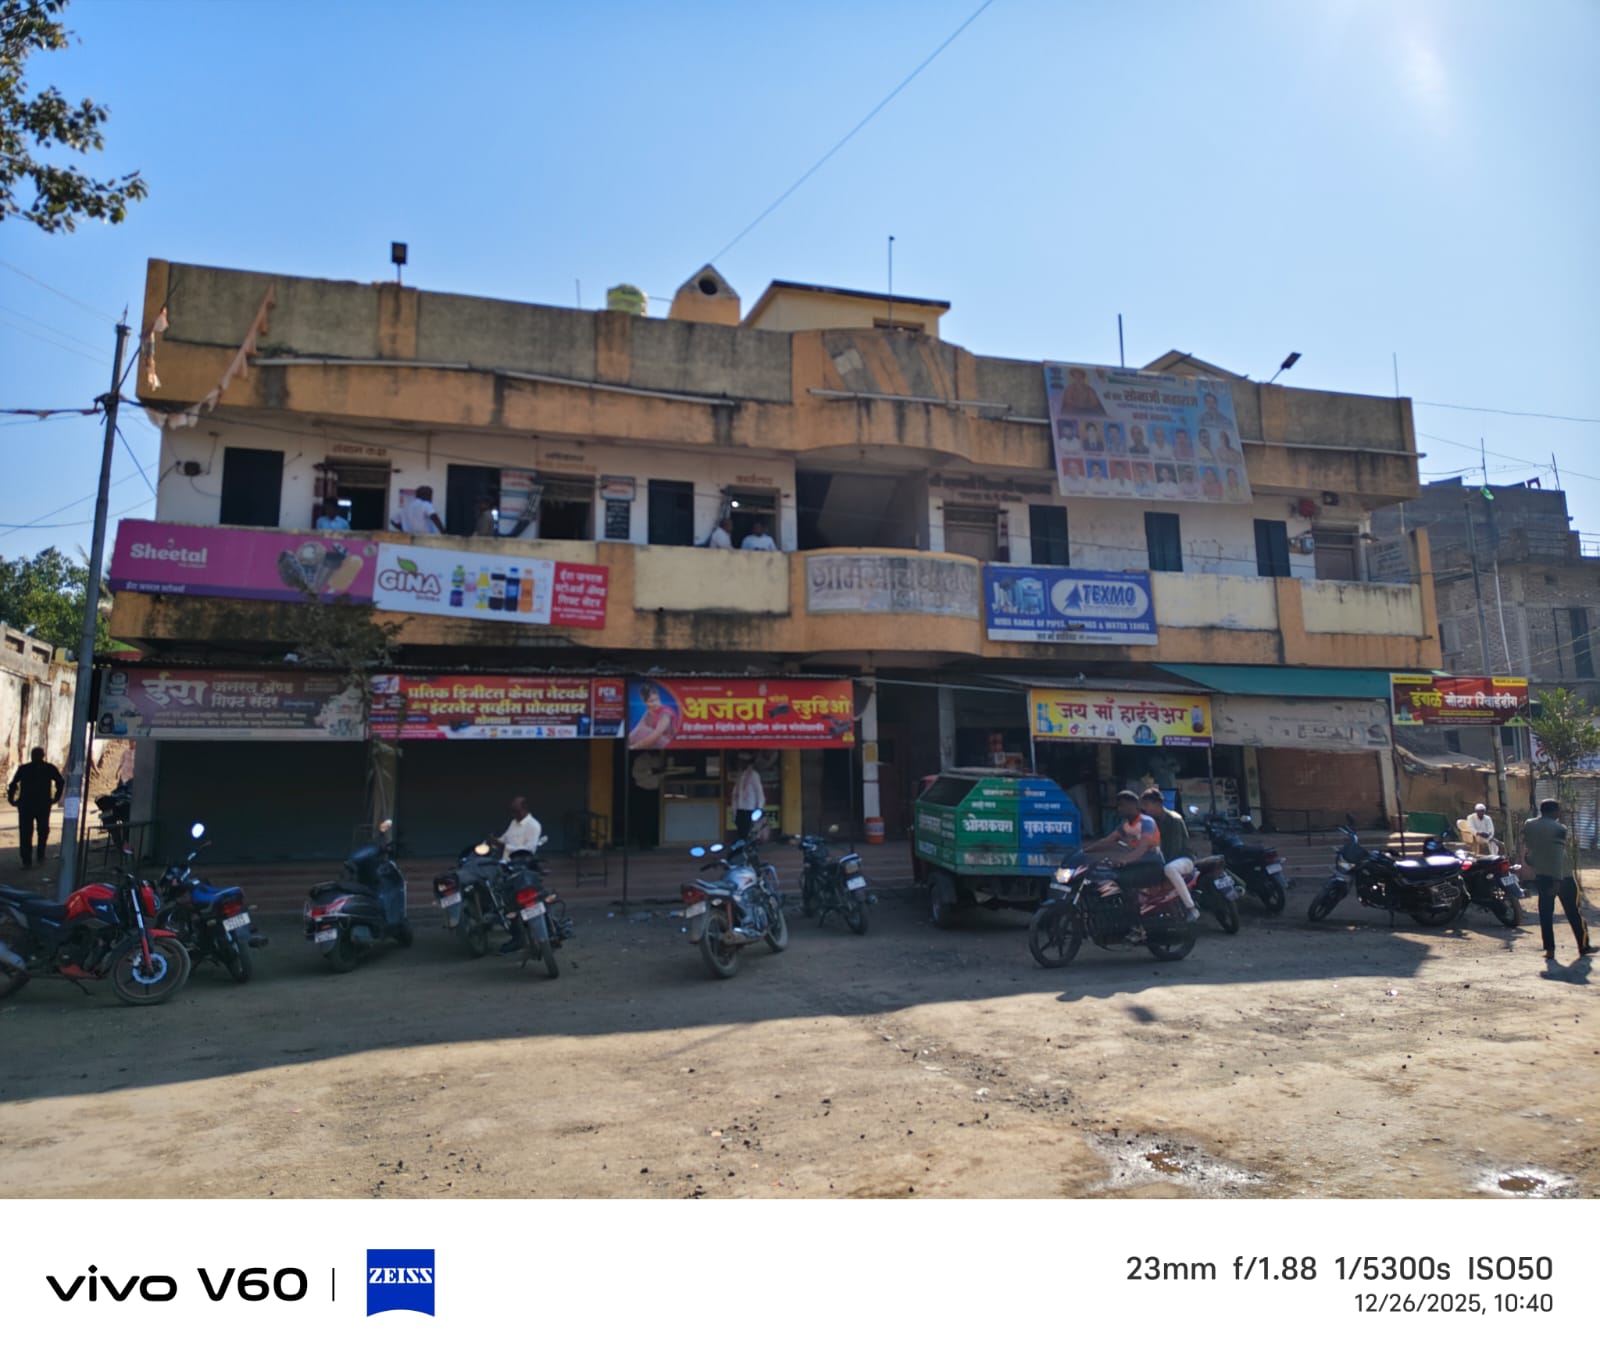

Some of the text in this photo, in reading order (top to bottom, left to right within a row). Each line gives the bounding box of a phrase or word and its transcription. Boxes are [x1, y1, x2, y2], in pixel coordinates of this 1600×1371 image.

[130, 542, 207, 564] Sheetal
[378, 569, 441, 595] GINA
[1082, 584, 1136, 606] TEXMO
[1013, 618, 1035, 627] RANGE
[1036, 619, 1043, 627] OF
[1105, 622, 1128, 630] WATER
[1129, 622, 1150, 631] TANKS
[508, 685, 544, 699] केबल
[546, 685, 589, 699] नेटवर्क
[682, 689, 766, 721] अजंठा
[792, 694, 851, 720] स्टुडिओ
[1055, 702, 1088, 720] जय
[1118, 700, 1188, 724] हार्डवेअर
